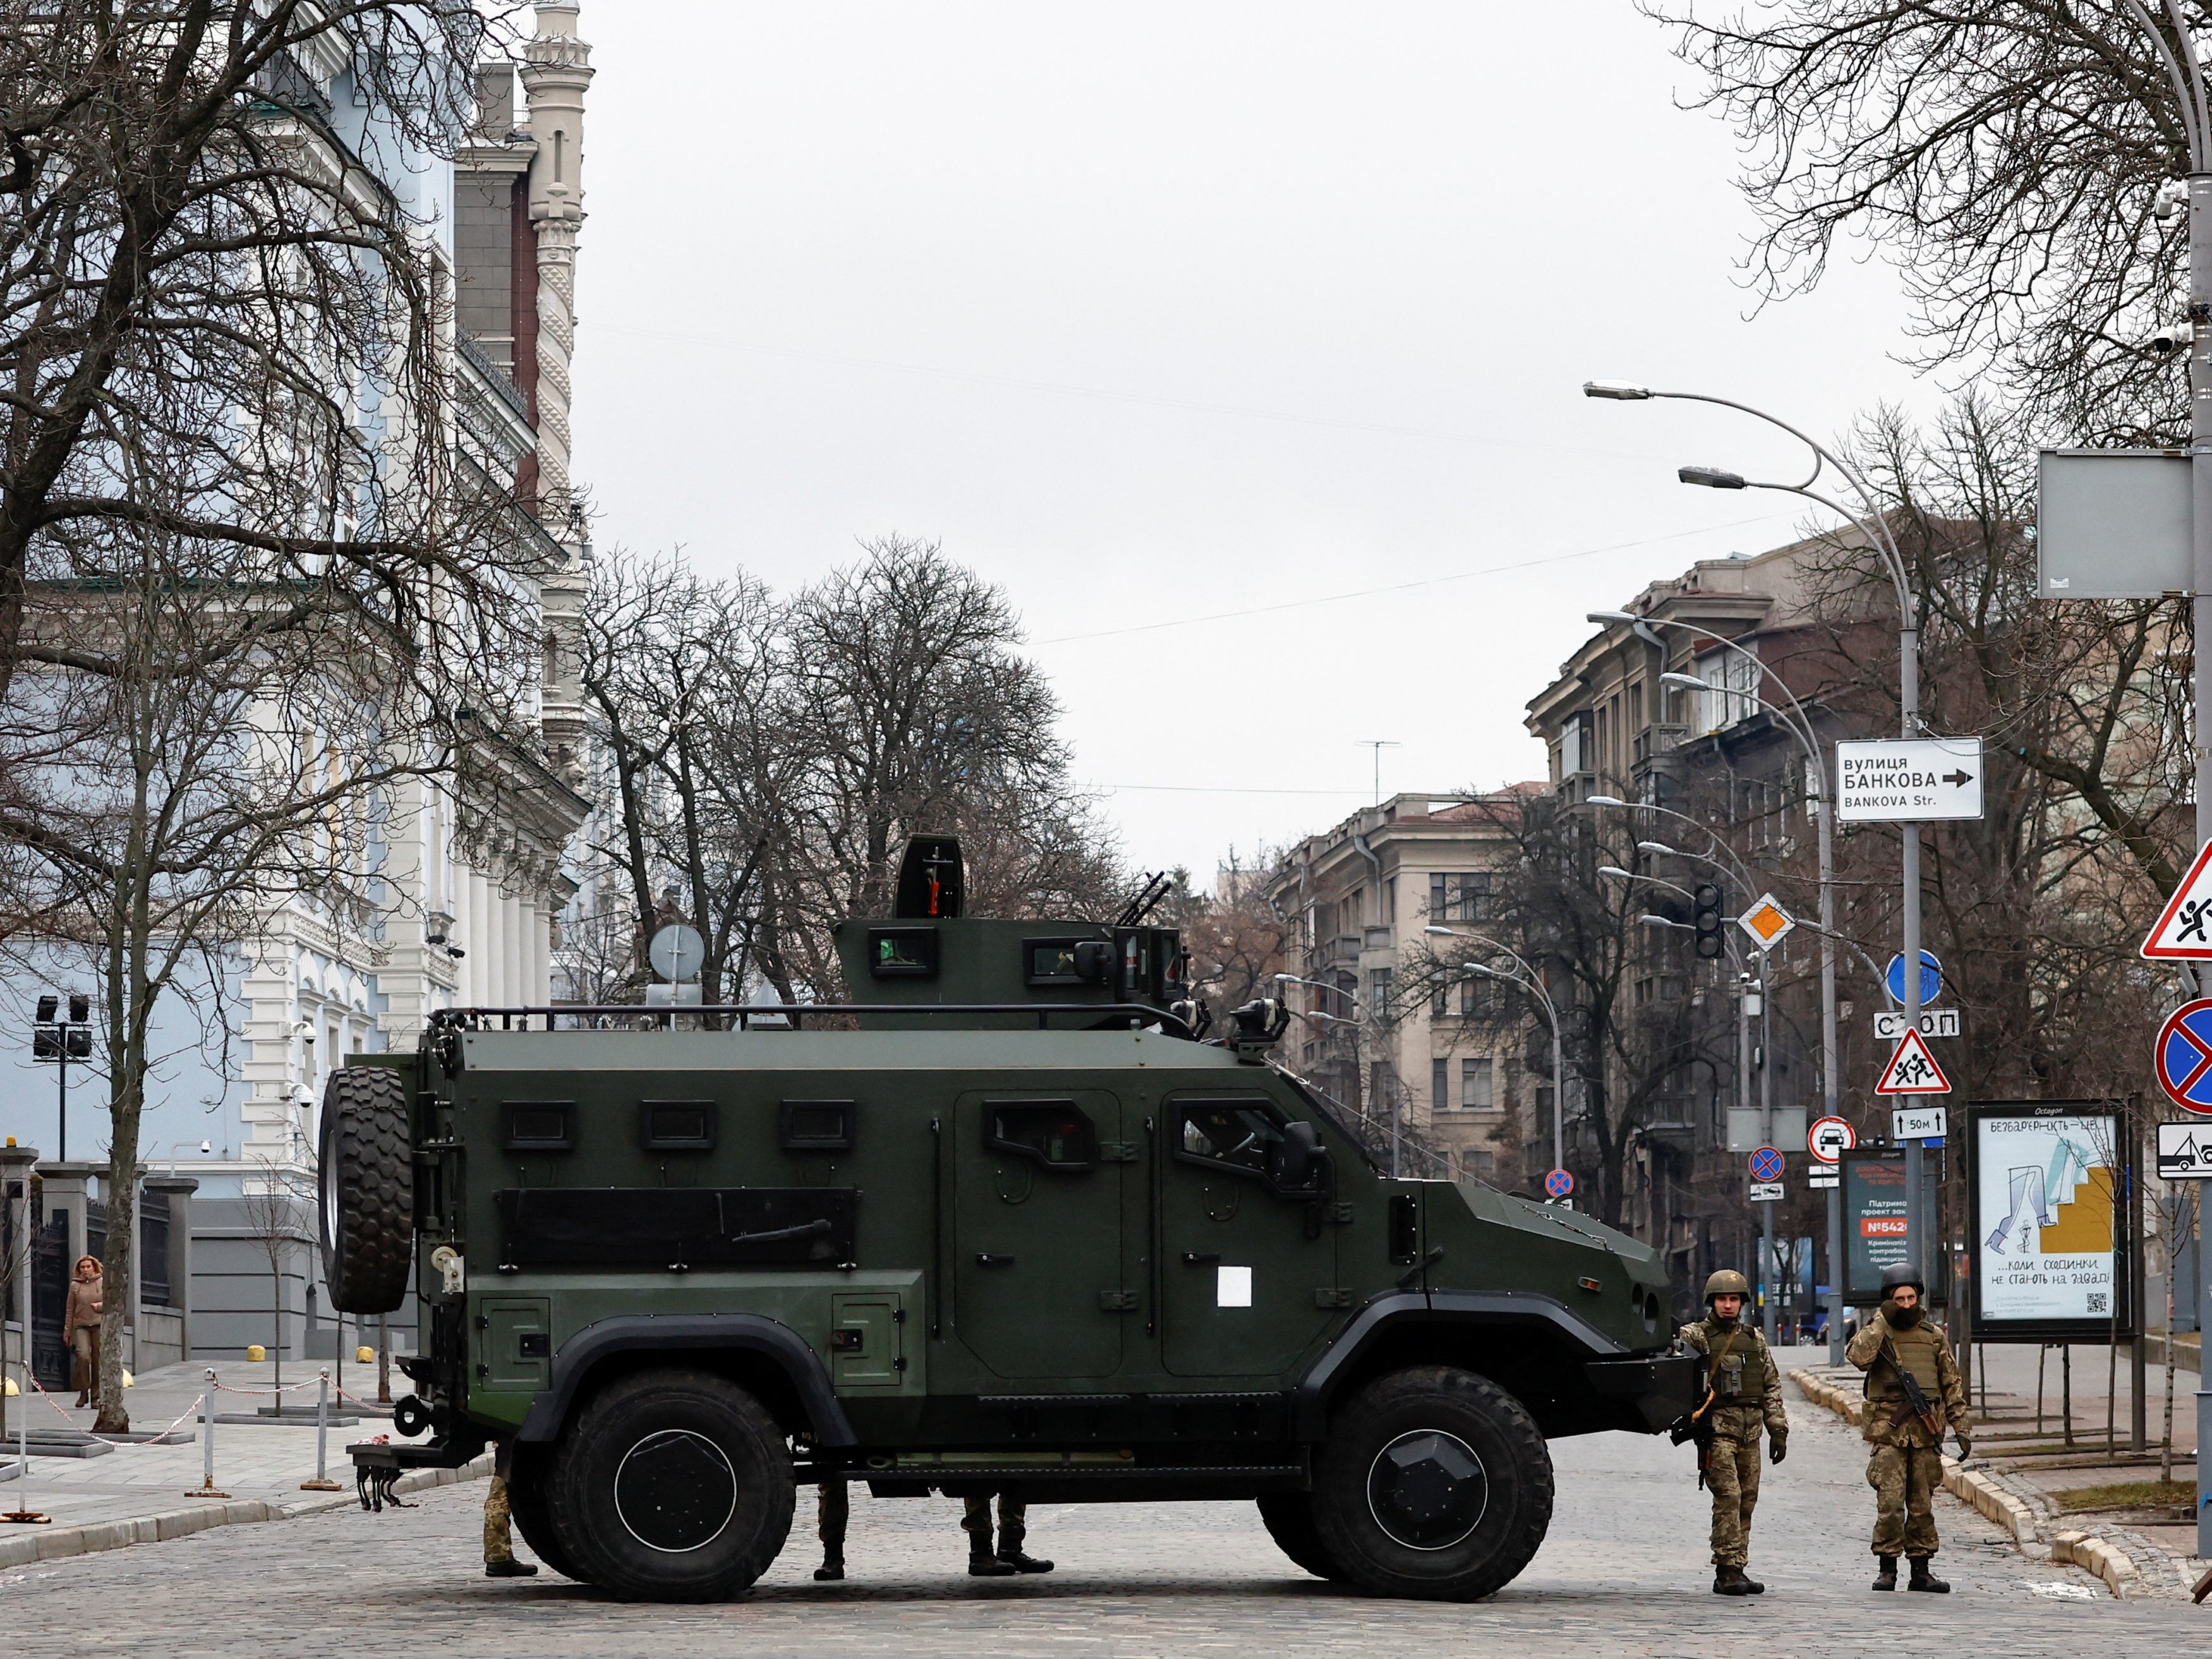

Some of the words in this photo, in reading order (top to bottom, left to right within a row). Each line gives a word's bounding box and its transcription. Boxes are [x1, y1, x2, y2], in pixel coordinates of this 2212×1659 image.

[1845, 773, 1937, 789] БАНКОВА
[1845, 796, 1907, 807] BANKOVA
[1914, 795, 1937, 806] Str.
[1878, 1015, 1955, 1035] СОП
[2034, 1107, 2063, 1116] Octagon
[1868, 1222, 1907, 1233] №542
